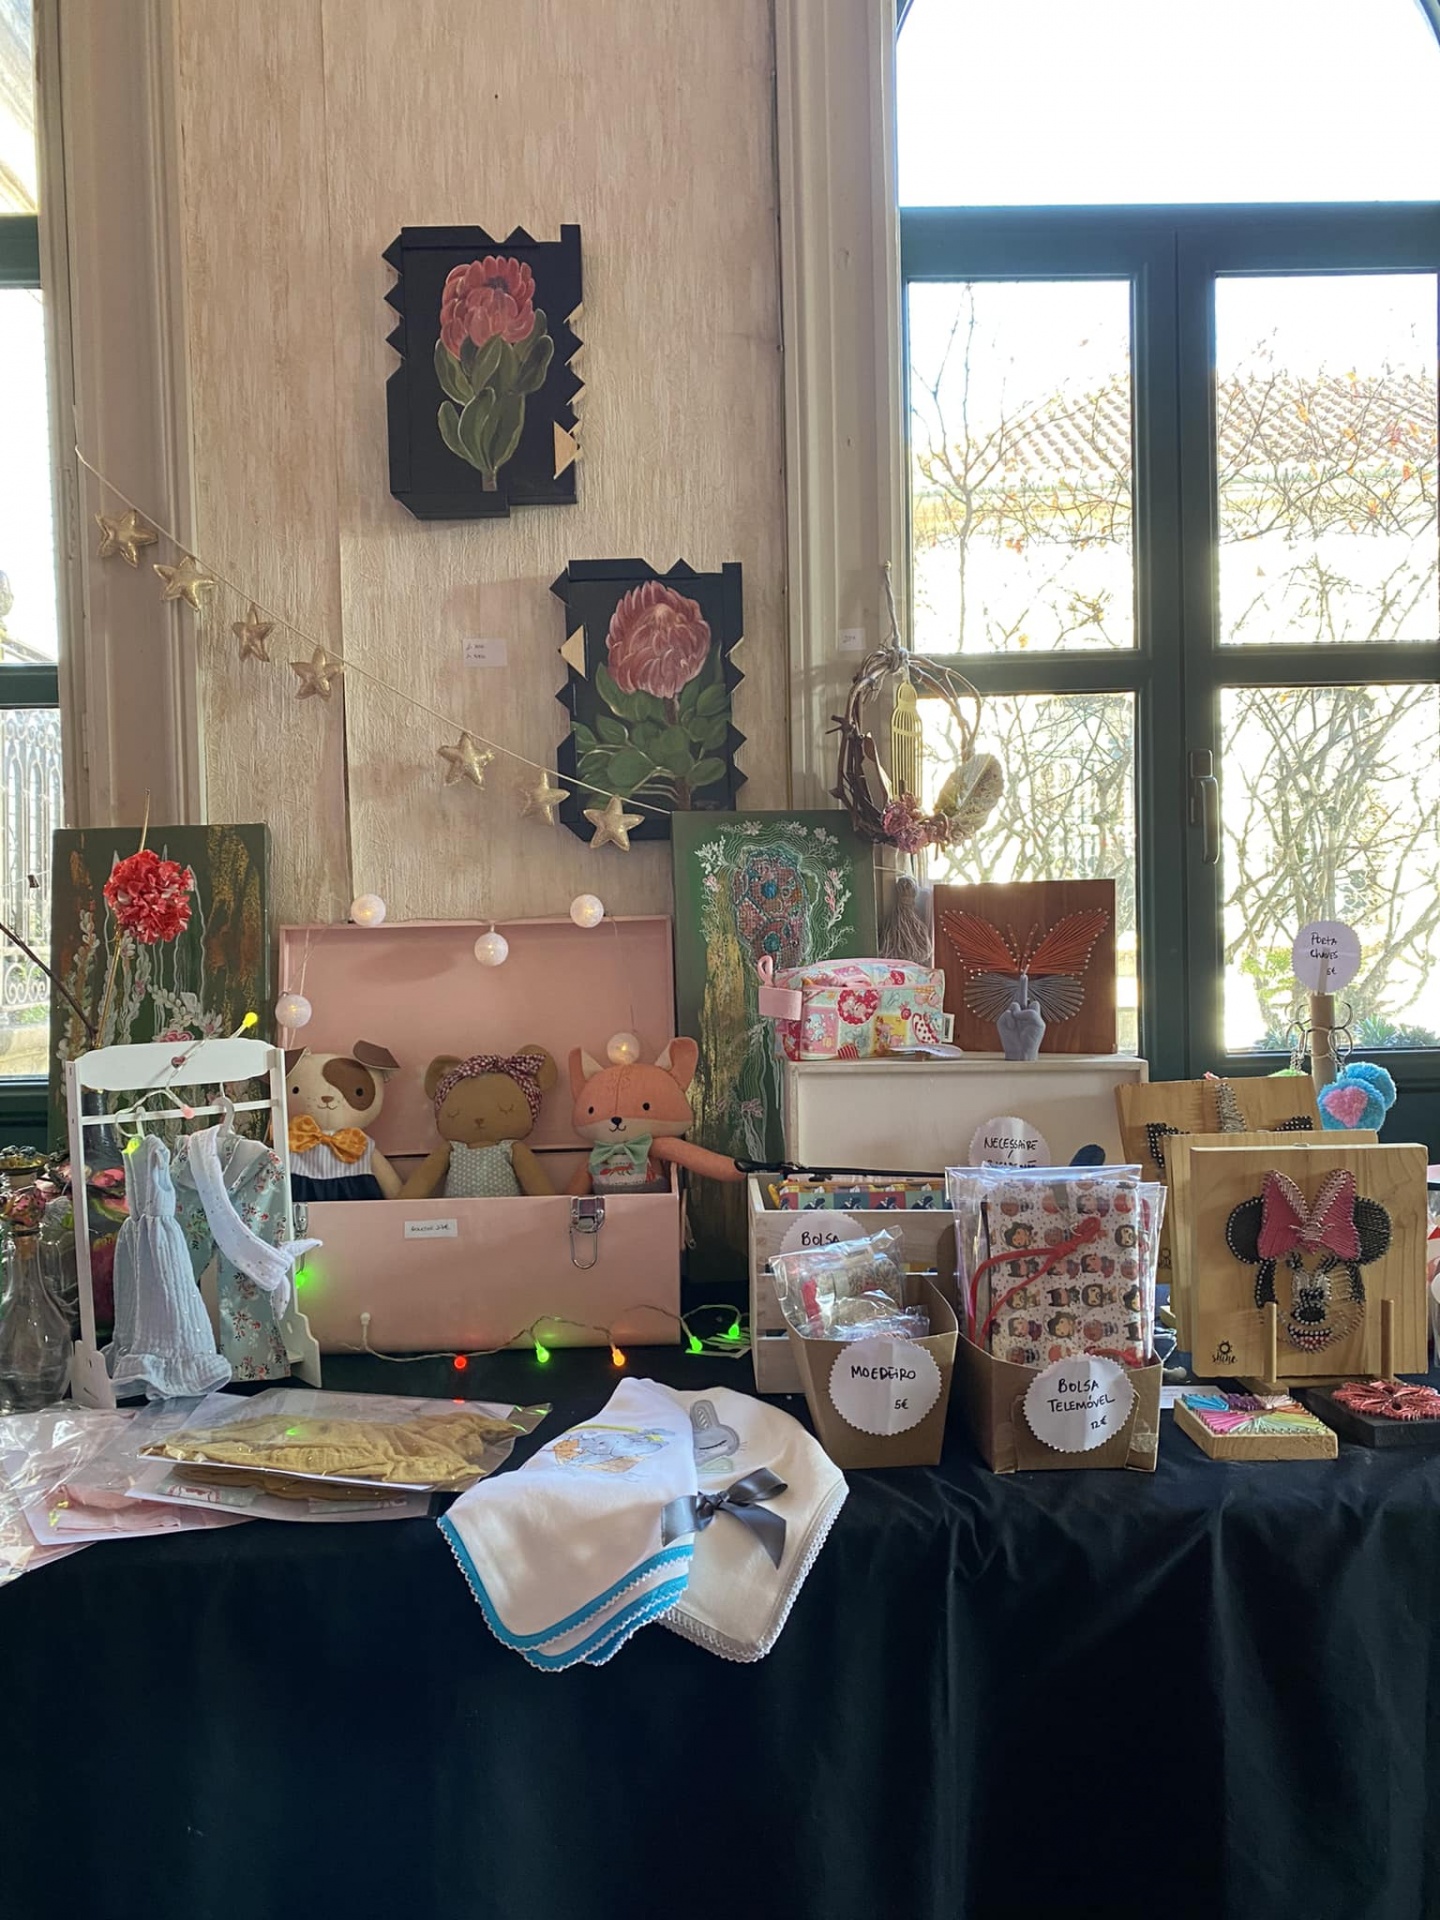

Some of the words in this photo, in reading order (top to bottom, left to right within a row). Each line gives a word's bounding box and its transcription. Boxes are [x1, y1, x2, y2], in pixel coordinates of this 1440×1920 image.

[801, 1231, 840, 1246] BOLSA
[1057, 1377, 1100, 1394] BOLSA
[893, 1398, 910, 1411] 5€
[1046, 1393, 1117, 1413] TELEMÓVEL
